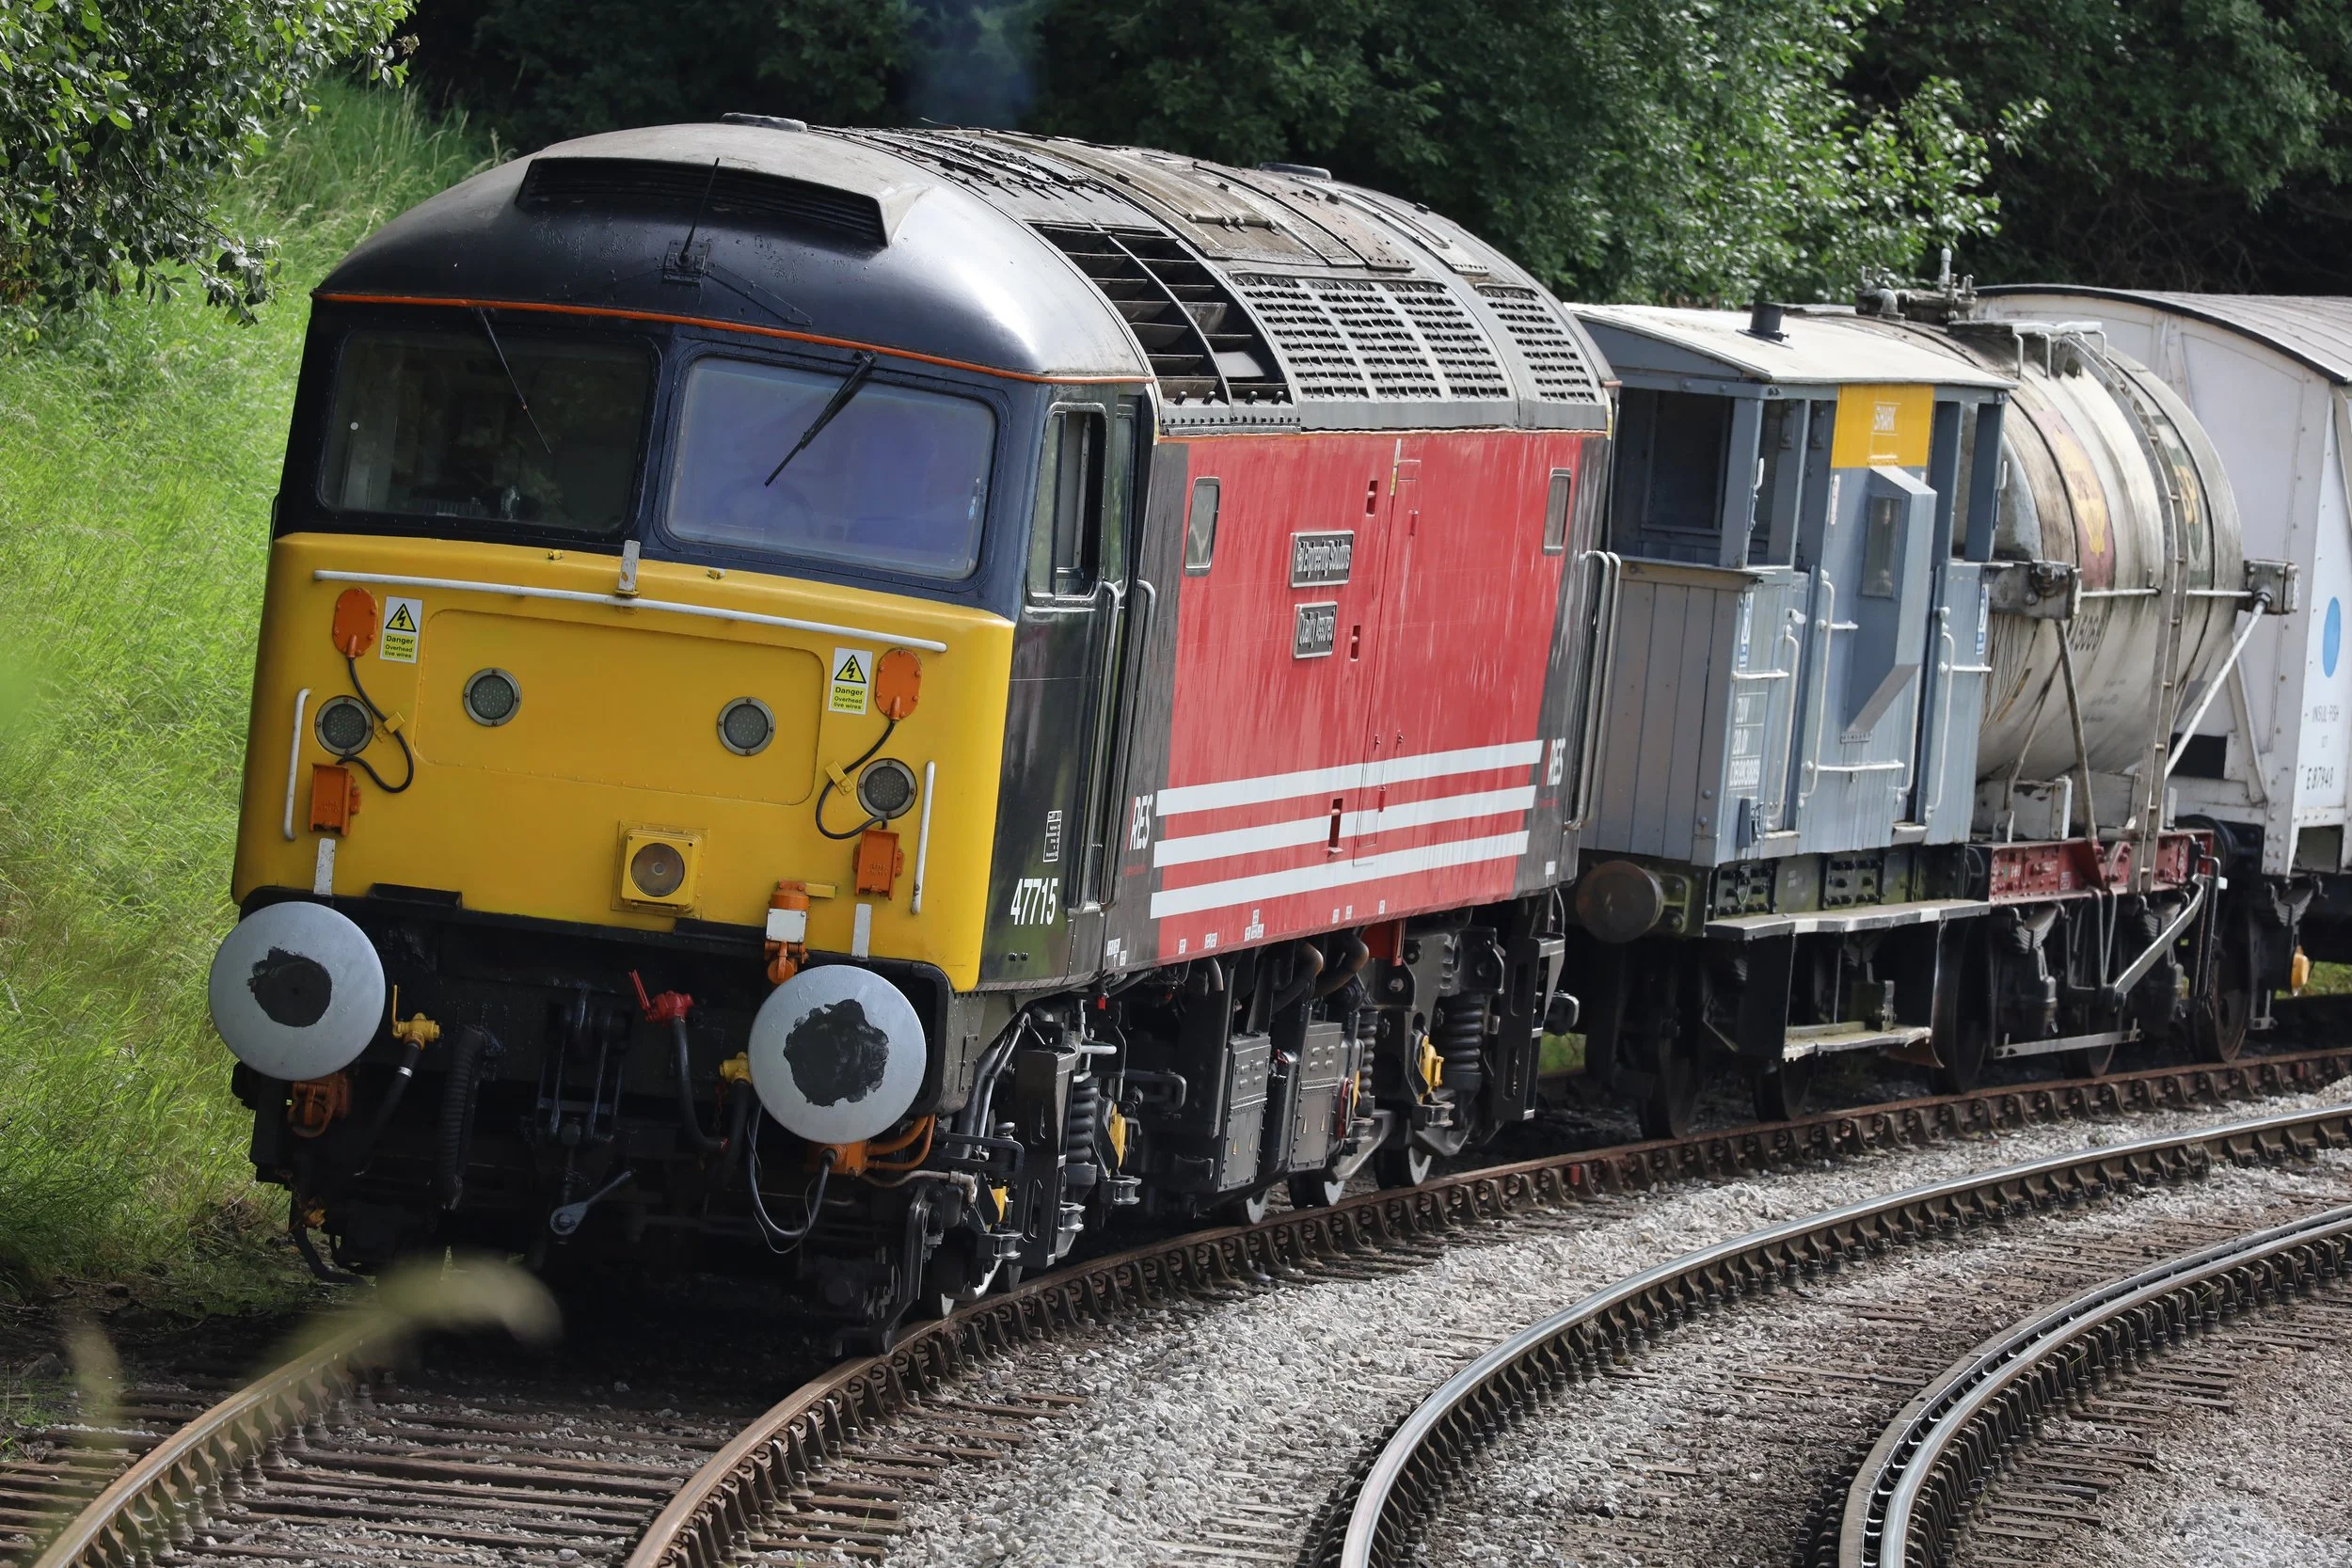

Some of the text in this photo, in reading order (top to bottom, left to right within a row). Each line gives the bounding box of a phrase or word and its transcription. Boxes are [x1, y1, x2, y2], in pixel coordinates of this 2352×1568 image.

[2172, 465, 2199, 524] BP
[385, 644, 414, 653] Overhead
[386, 635, 414, 645] Danger
[1299, 609, 1336, 649] Quality Assured
[834, 686, 864, 697] Danger
[834, 695, 863, 705] Overhead
[1547, 736, 1566, 786] RES
[1129, 793, 1154, 851] RES
[1009, 877, 1059, 926] 47715
